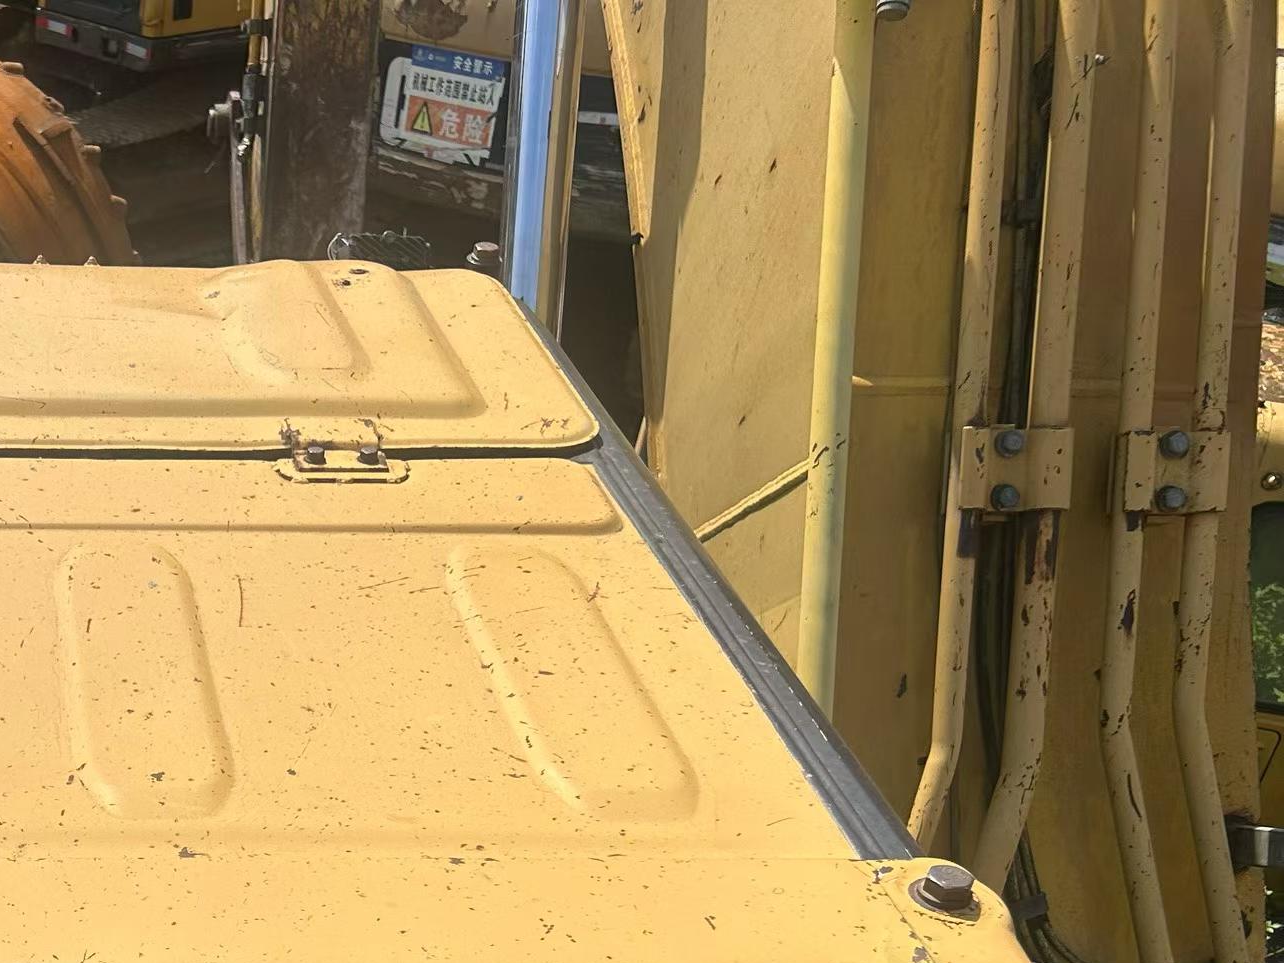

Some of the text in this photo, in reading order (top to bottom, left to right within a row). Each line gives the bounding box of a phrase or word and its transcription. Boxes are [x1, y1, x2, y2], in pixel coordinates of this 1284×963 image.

[453, 55, 494, 75] 安全警示
[439, 108, 484, 145] 危险
